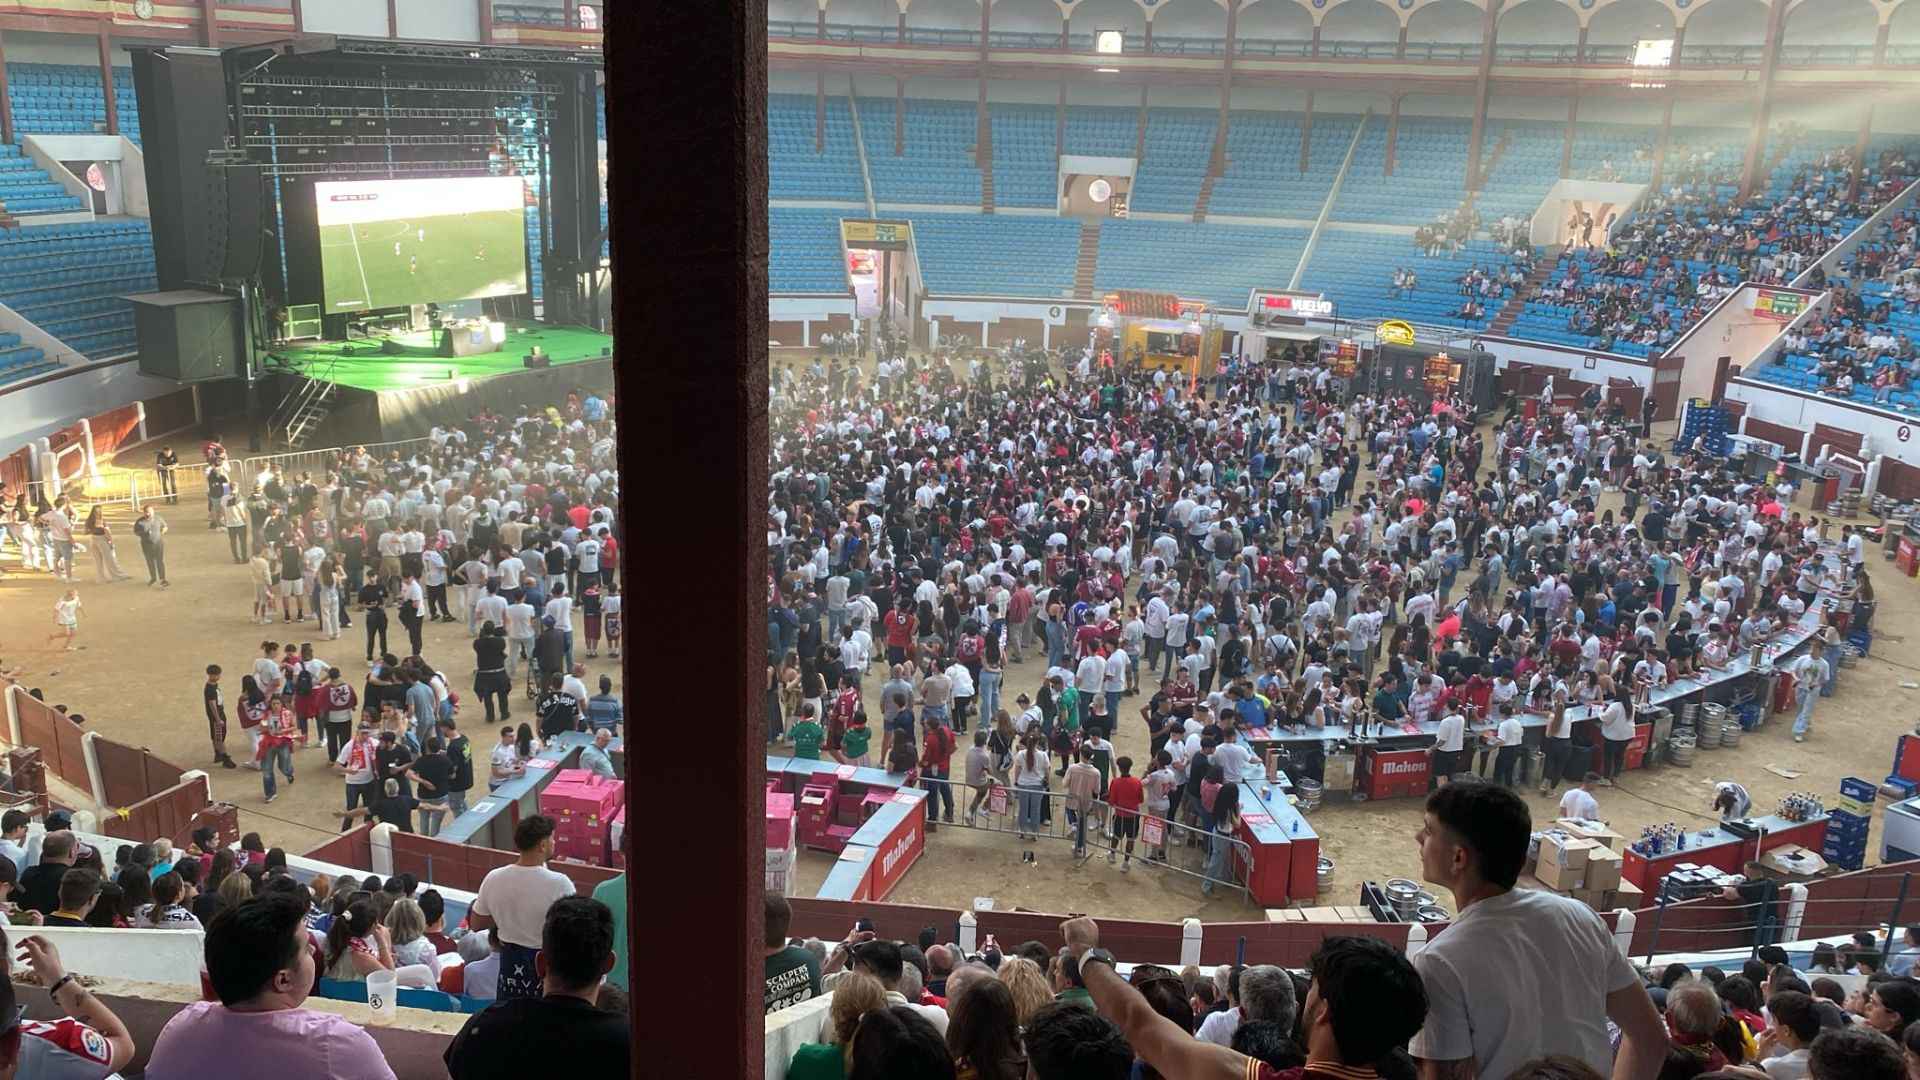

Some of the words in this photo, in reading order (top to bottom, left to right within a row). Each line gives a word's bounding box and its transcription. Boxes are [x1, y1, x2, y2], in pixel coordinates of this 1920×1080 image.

[1292, 299, 1332, 313] VUELVO
[1900, 428, 1908, 440] 2
[1383, 760, 1427, 775] Mahou
[883, 826, 915, 877] Mahou
[766, 964, 808, 988] SCALPERS
[771, 973, 810, 993] COMPANY
